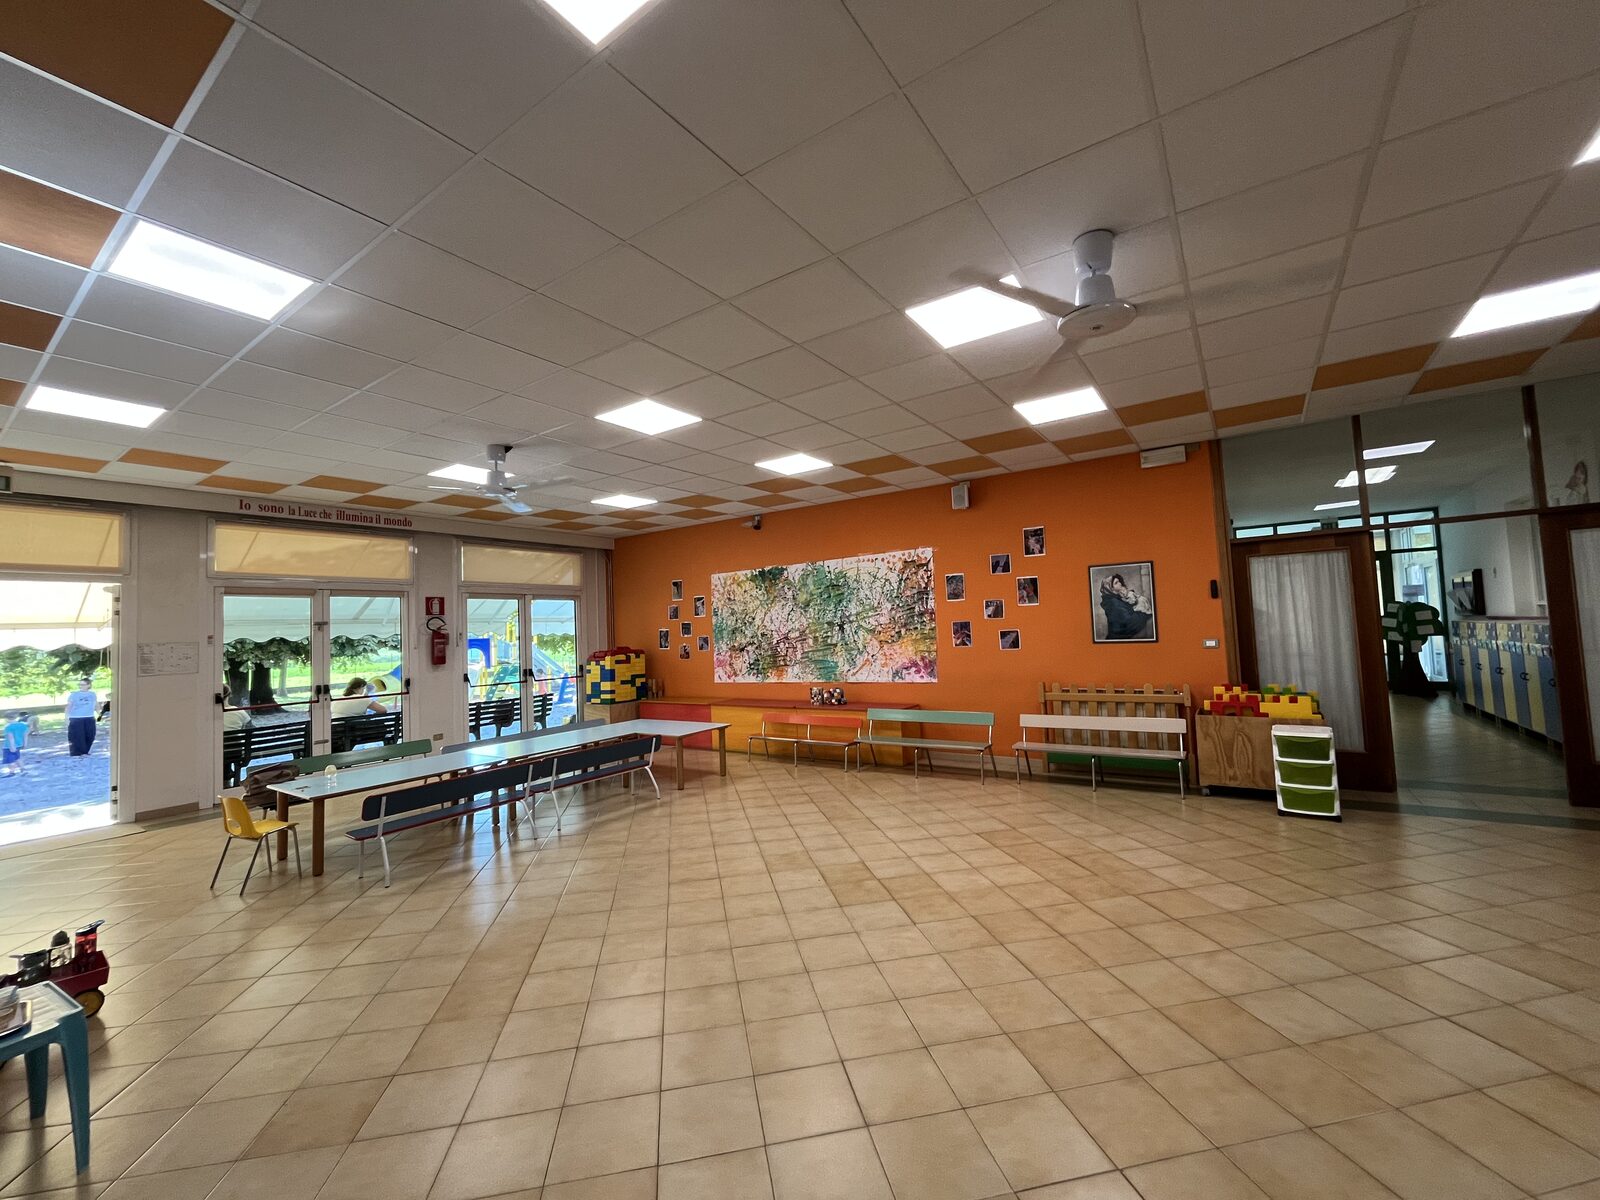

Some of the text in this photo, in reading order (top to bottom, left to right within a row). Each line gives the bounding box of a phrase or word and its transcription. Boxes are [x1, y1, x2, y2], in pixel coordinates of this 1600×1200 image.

[239, 499, 413, 528] Io sono la Luce che illumina il mondo
